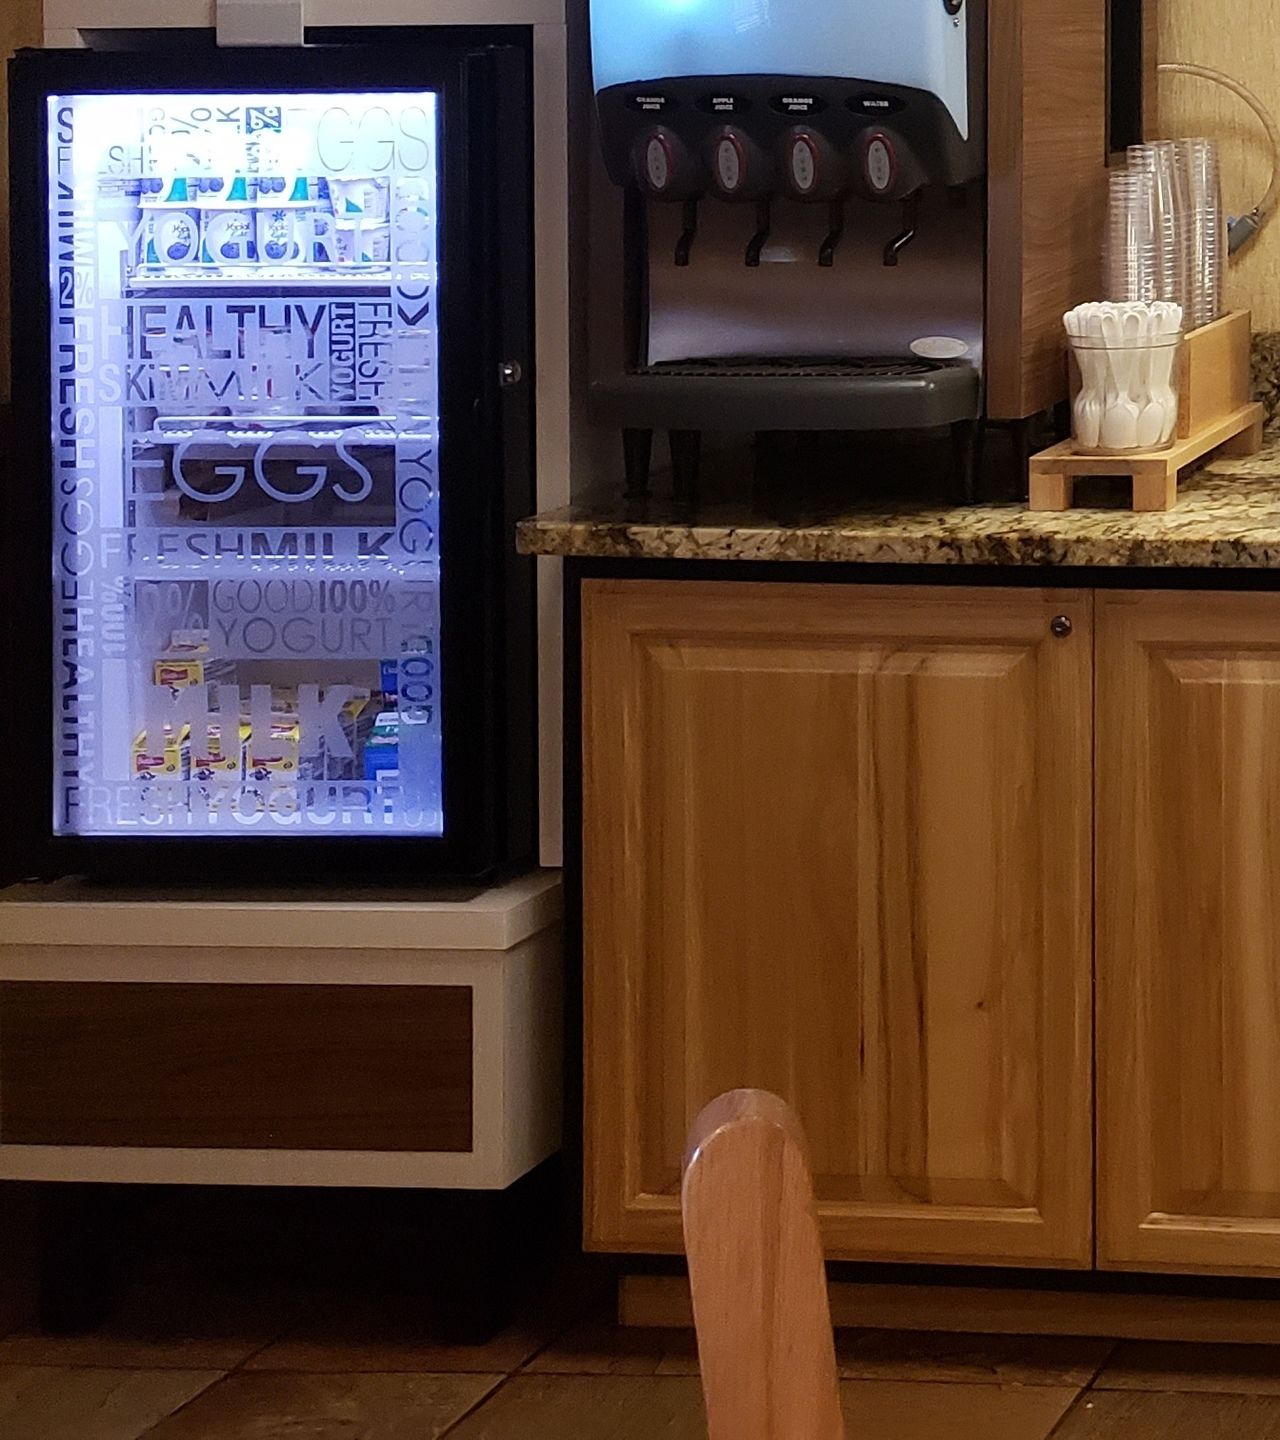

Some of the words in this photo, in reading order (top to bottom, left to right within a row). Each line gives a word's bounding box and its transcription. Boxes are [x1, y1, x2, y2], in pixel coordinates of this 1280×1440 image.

[100, 304, 327, 360] HEALTHY
[330, 302, 355, 401] YOGURT
[59, 316, 96, 469] FRESH
[131, 426, 374, 503] EGGS
[60, 477, 95, 600] EGGS
[212, 579, 314, 614] GOOD
[318, 578, 396, 615] 100%
[216, 617, 393, 653] YOGURT
